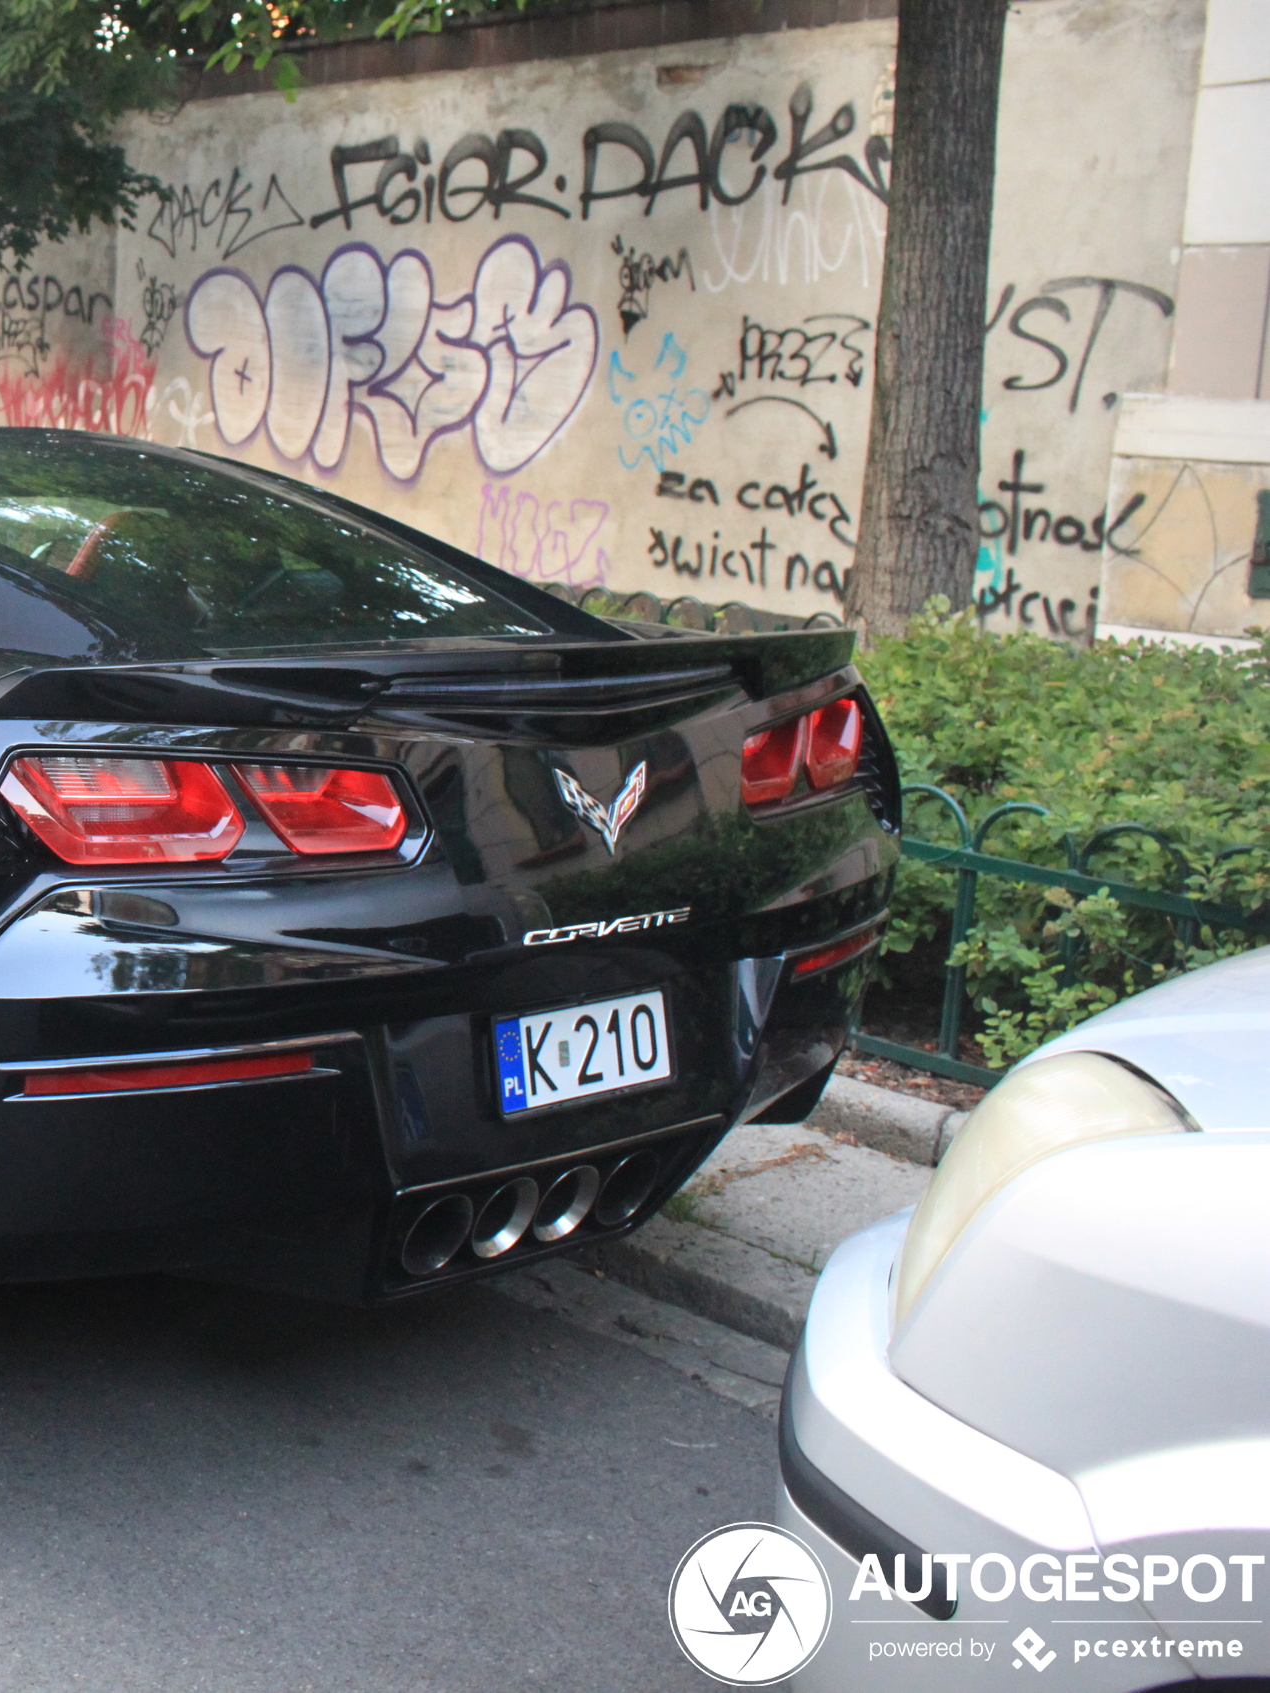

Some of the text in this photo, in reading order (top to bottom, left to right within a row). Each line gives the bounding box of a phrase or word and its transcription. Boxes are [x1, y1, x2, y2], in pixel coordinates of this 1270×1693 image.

[523, 906, 691, 946] CORVETTE
[524, 1003, 659, 1096] K 210
[504, 1076, 525, 1098] PL
